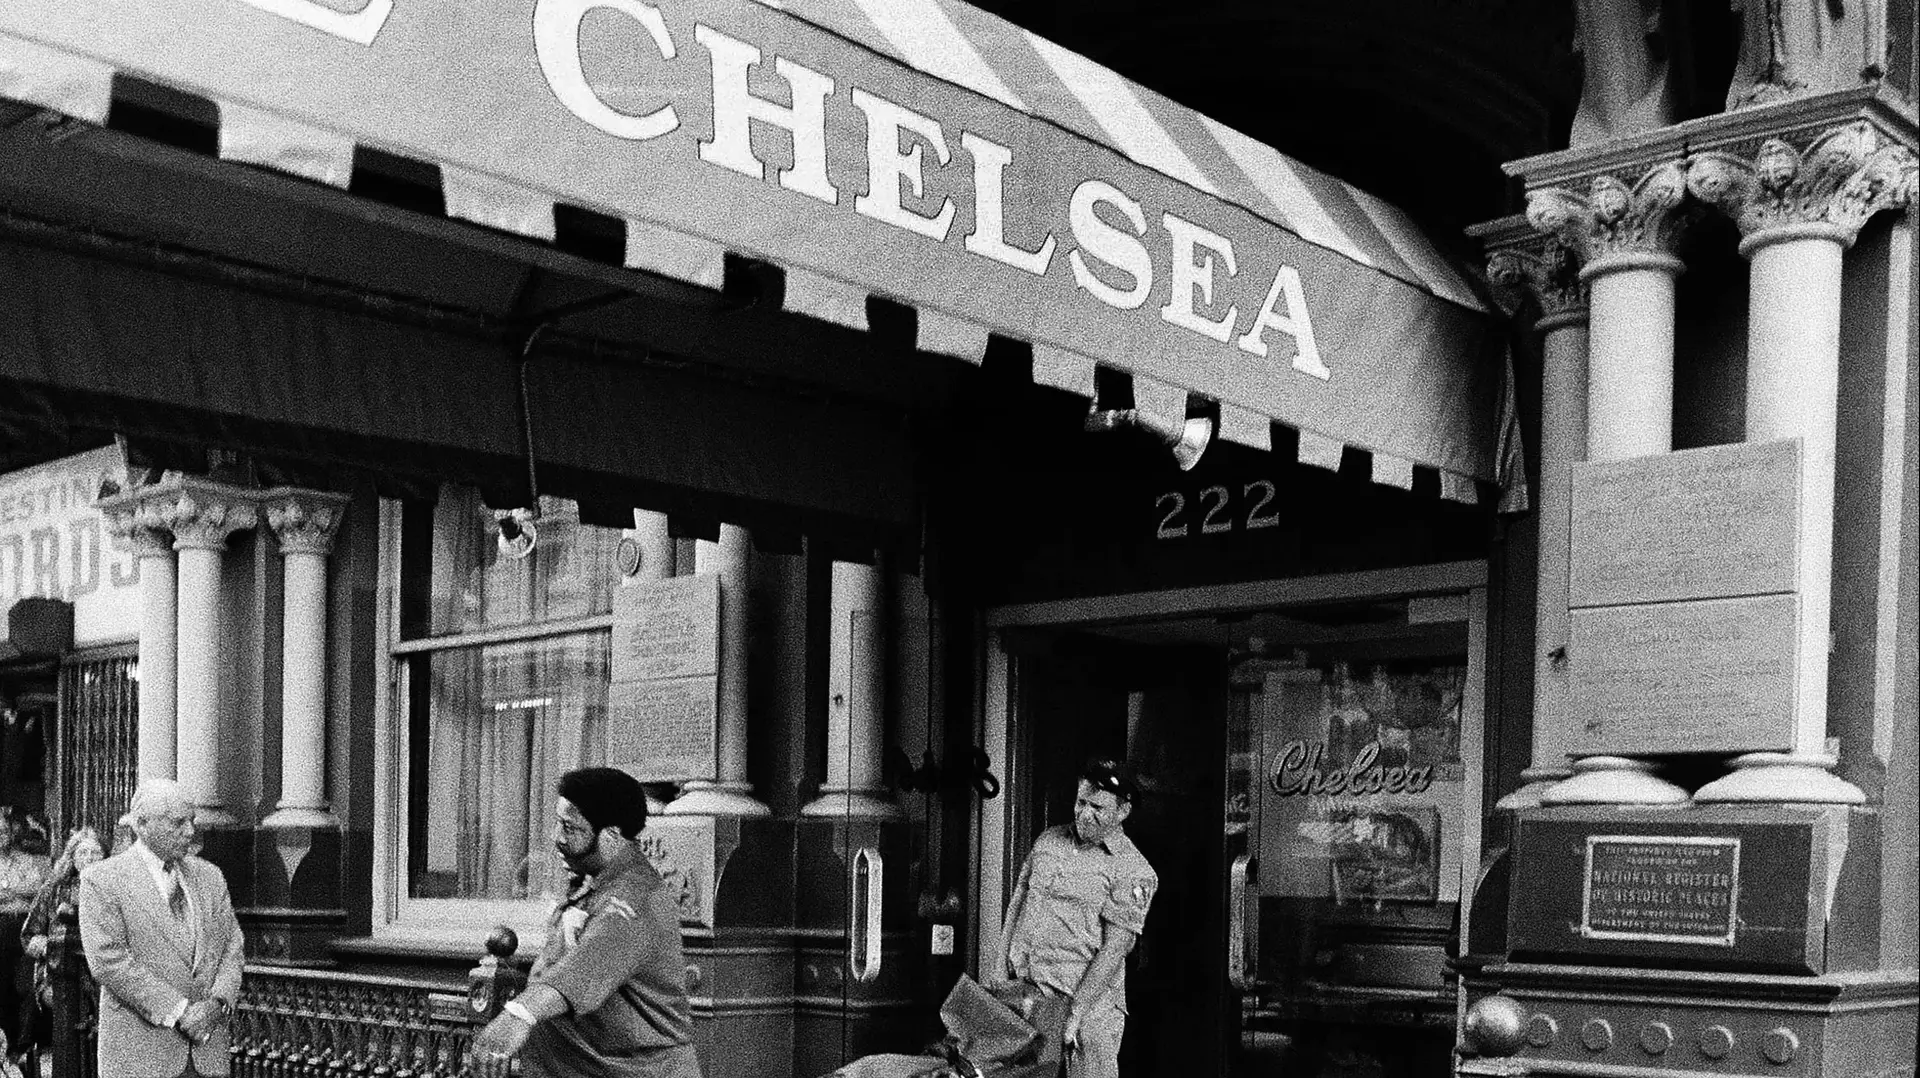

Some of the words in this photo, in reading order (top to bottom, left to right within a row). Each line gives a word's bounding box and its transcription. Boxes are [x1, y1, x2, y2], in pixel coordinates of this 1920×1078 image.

[533, 0, 1331, 380] CHELSEA
[1155, 480, 1279, 539] 222
[1270, 740, 1433, 796] Chelsea
[1665, 872, 1730, 887] REGISTER
